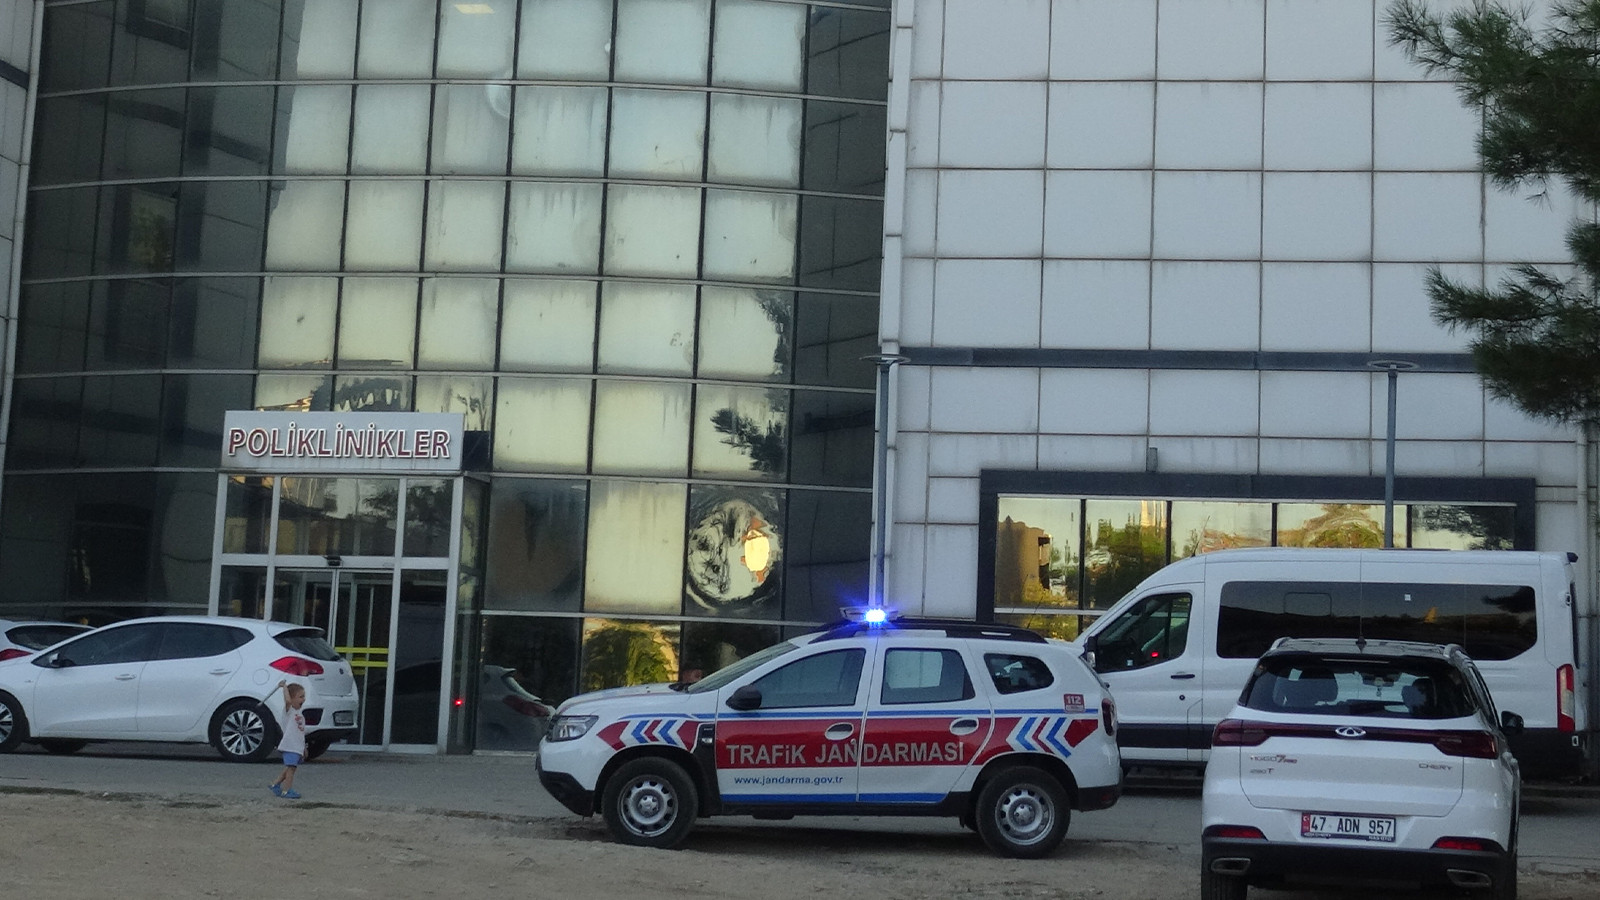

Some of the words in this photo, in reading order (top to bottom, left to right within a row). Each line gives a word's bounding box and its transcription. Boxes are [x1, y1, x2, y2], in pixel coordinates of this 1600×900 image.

[227, 421, 451, 459] POLİKLİNİKLER
[1066, 695, 1082, 705] 112
[734, 775, 843, 786] www.jandarma.gov.tr
[1311, 816, 1327, 831] 47
[1336, 818, 1360, 834] ADN
[1368, 820, 1392, 836] 957
